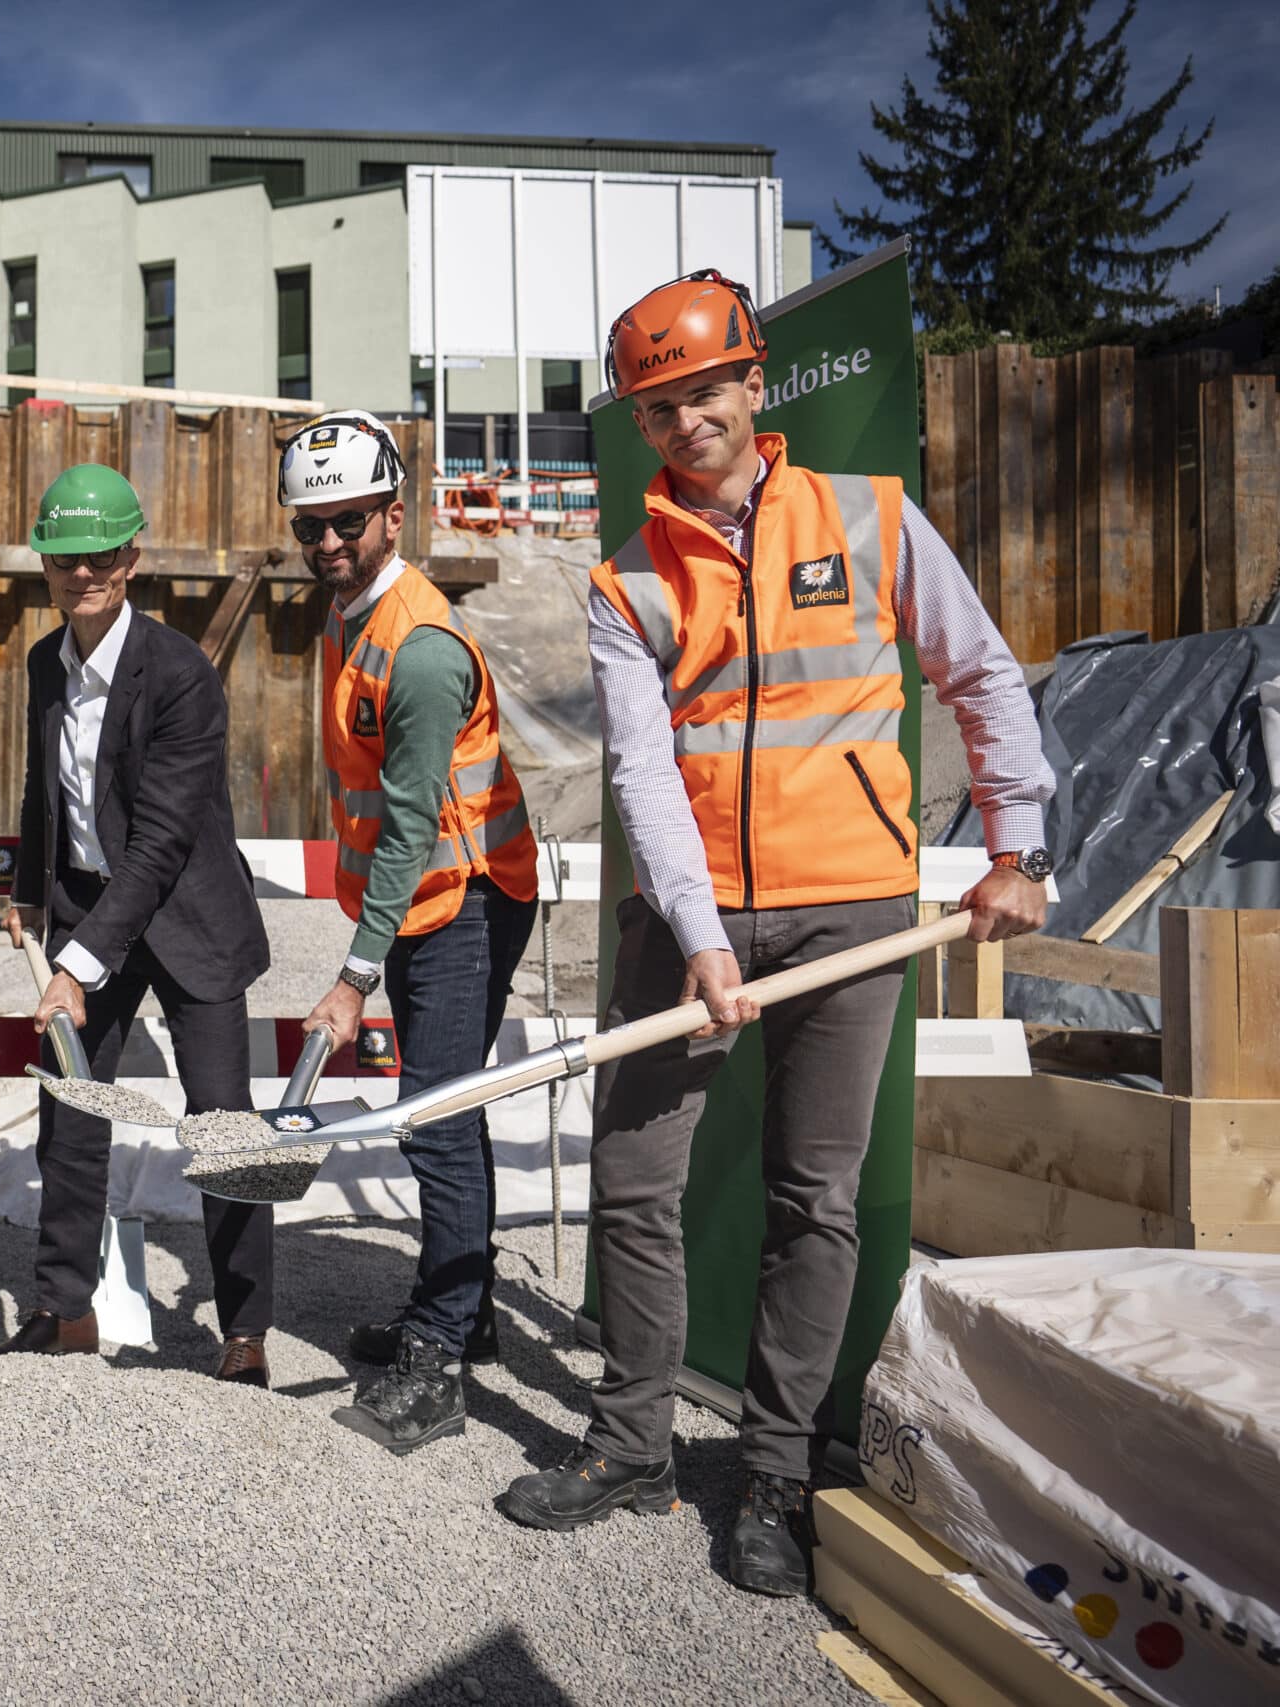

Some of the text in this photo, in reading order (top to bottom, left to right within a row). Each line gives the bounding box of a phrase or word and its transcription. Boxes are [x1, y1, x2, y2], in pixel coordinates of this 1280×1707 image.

[639, 345, 686, 371] KASK
[754, 347, 871, 413] udoise
[305, 473, 343, 488] KASK
[60, 506, 100, 517] vaudoise
[796, 588, 845, 605] Implenia
[858, 1400, 923, 1504] PS
